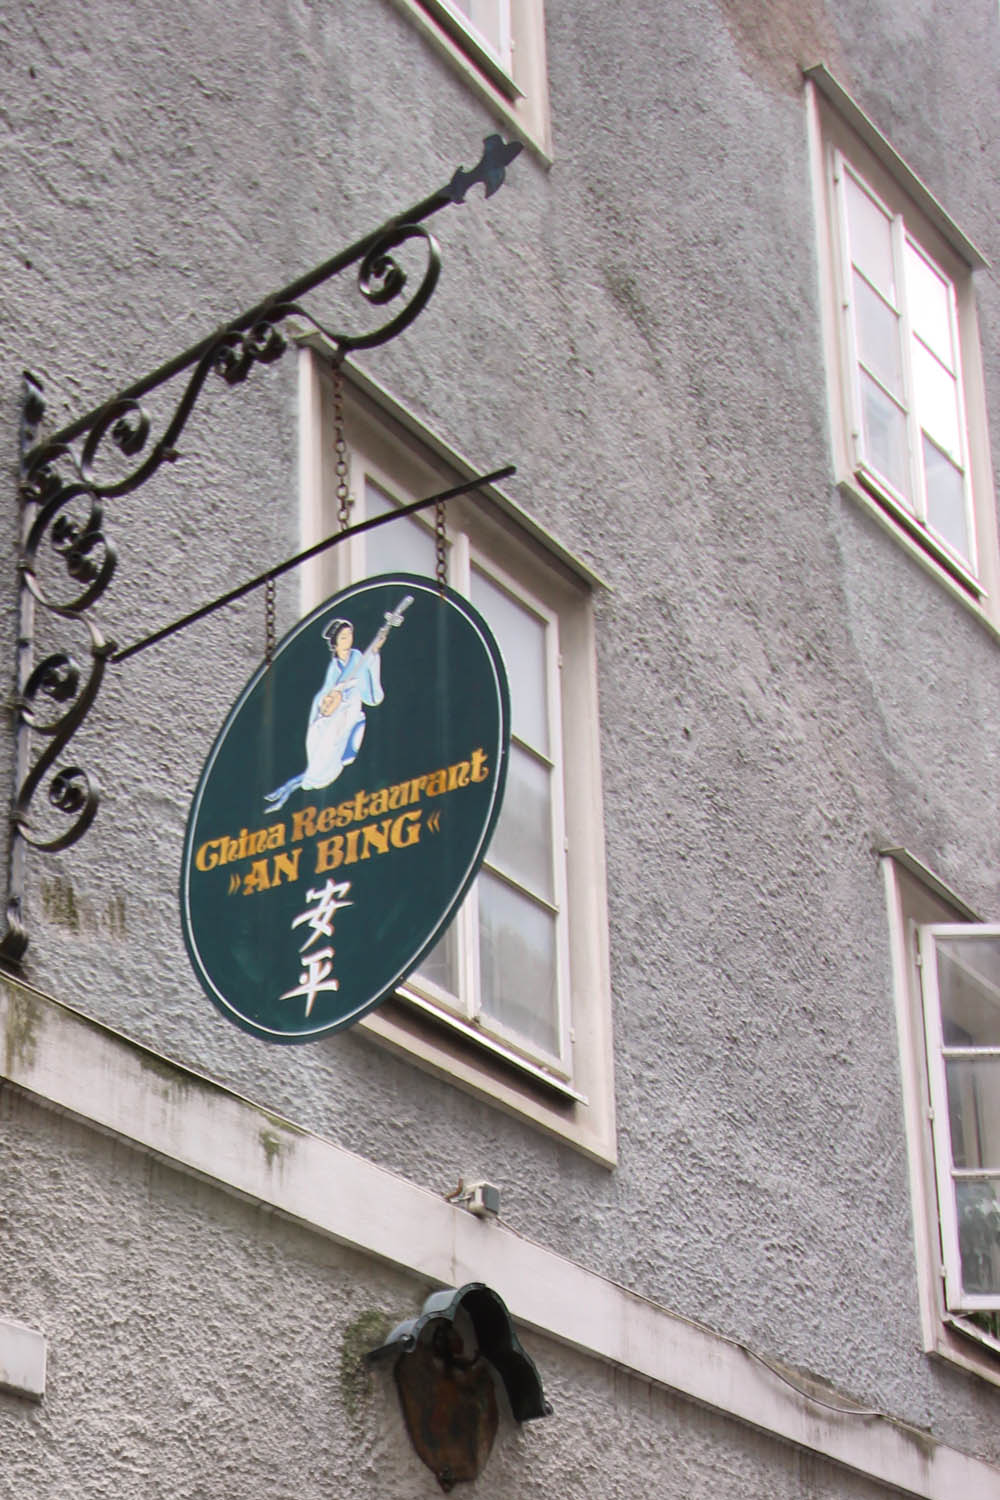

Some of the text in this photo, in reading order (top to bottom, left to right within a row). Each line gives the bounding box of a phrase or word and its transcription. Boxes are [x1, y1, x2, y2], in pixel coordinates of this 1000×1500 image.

[195, 747, 489, 872] China Restaurant
[280, 878, 354, 1018] 安平
